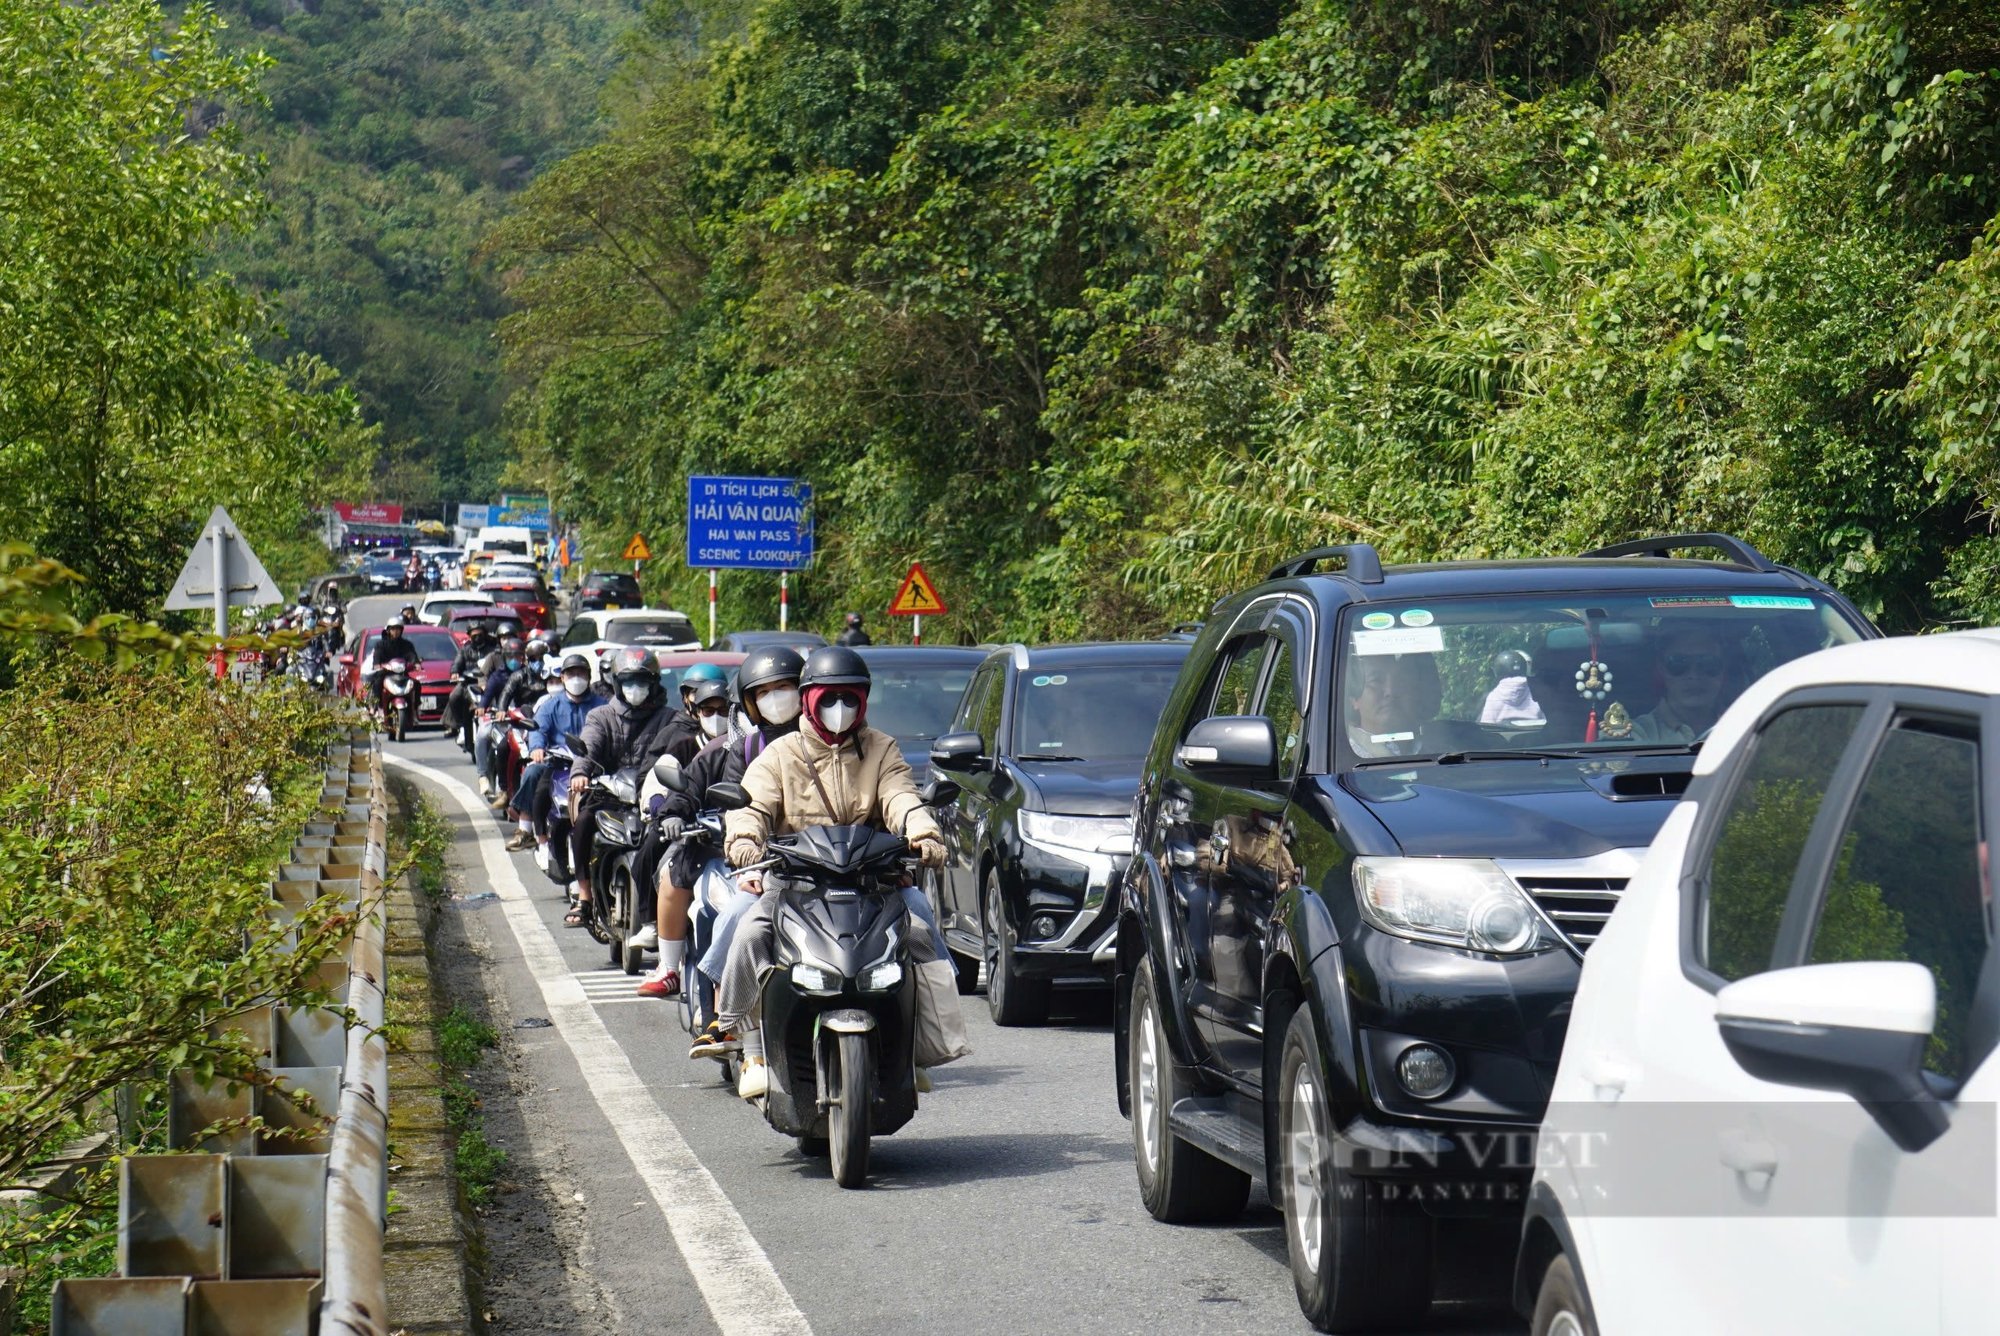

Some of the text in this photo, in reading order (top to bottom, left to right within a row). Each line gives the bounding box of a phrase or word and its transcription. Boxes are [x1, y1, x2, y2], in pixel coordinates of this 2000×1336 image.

[704, 484, 717, 496] DI
[721, 482, 747, 496] TÍCH
[752, 485, 778, 499] LỊCH
[694, 499, 723, 520] HẢI
[727, 501, 758, 521] VÂN
[708, 529, 791, 542] HAI VAN PASS
[699, 549, 802, 562] SCENIC LOOKOUT
